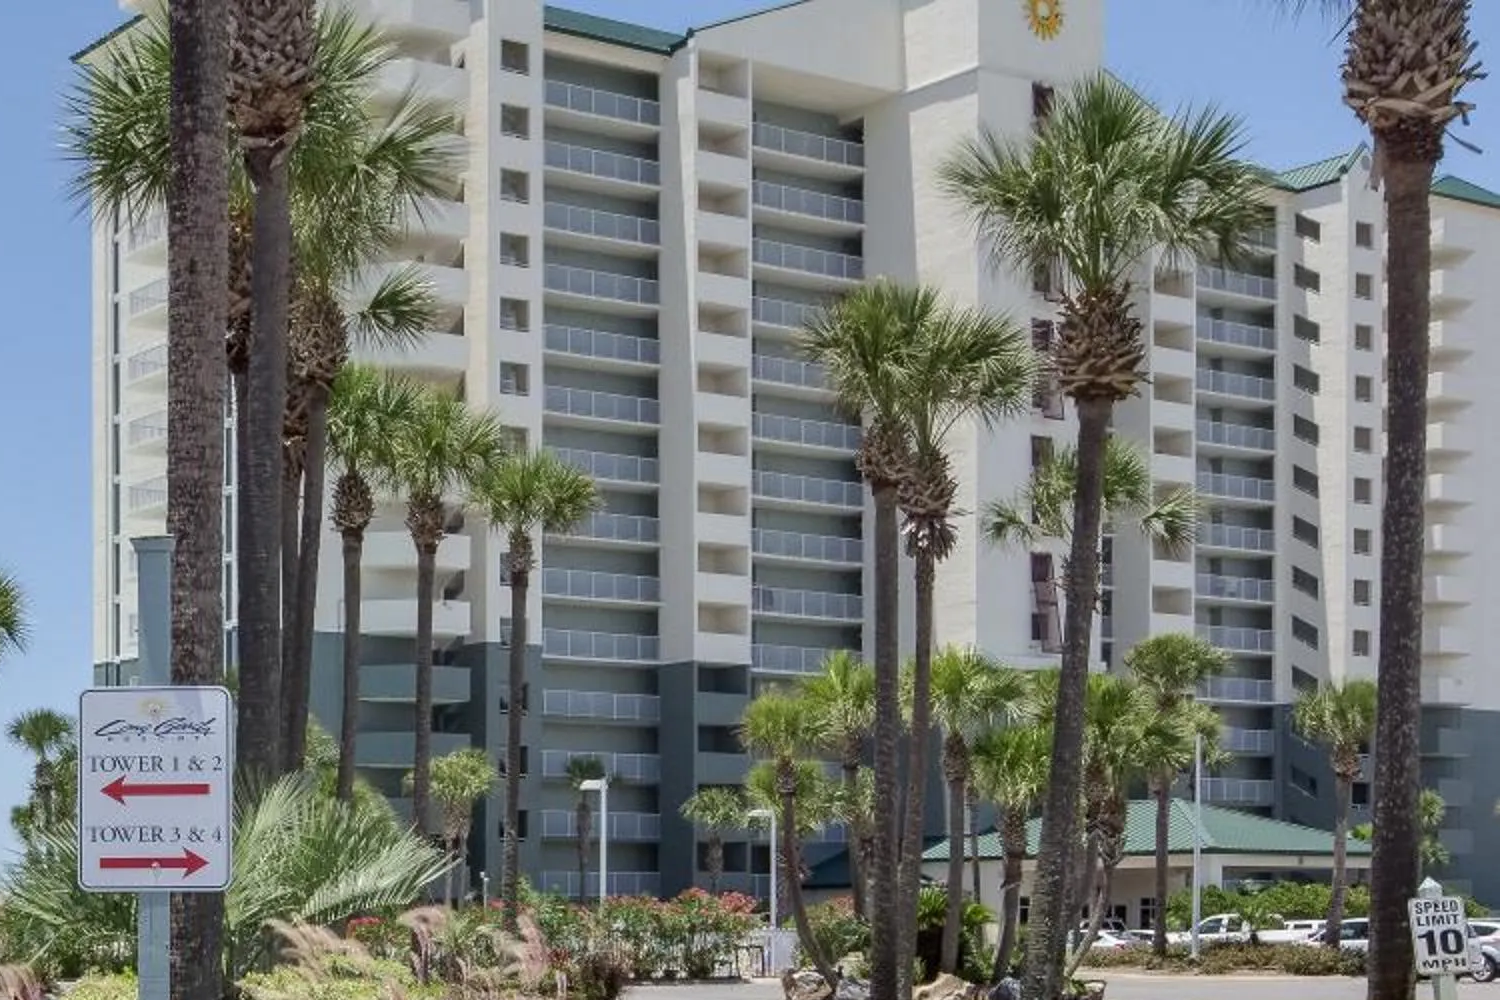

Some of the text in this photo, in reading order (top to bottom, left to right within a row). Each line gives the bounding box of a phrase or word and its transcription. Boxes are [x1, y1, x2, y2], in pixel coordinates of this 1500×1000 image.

[88, 756, 222, 772] TOWER 1 & 2
[88, 827, 222, 842] TOWER 3 & 4
[1414, 900, 1459, 915] SPEED
[1417, 914, 1460, 927] LIMIT
[1417, 929, 1465, 956] 10
[1422, 957, 1467, 969] MPH
